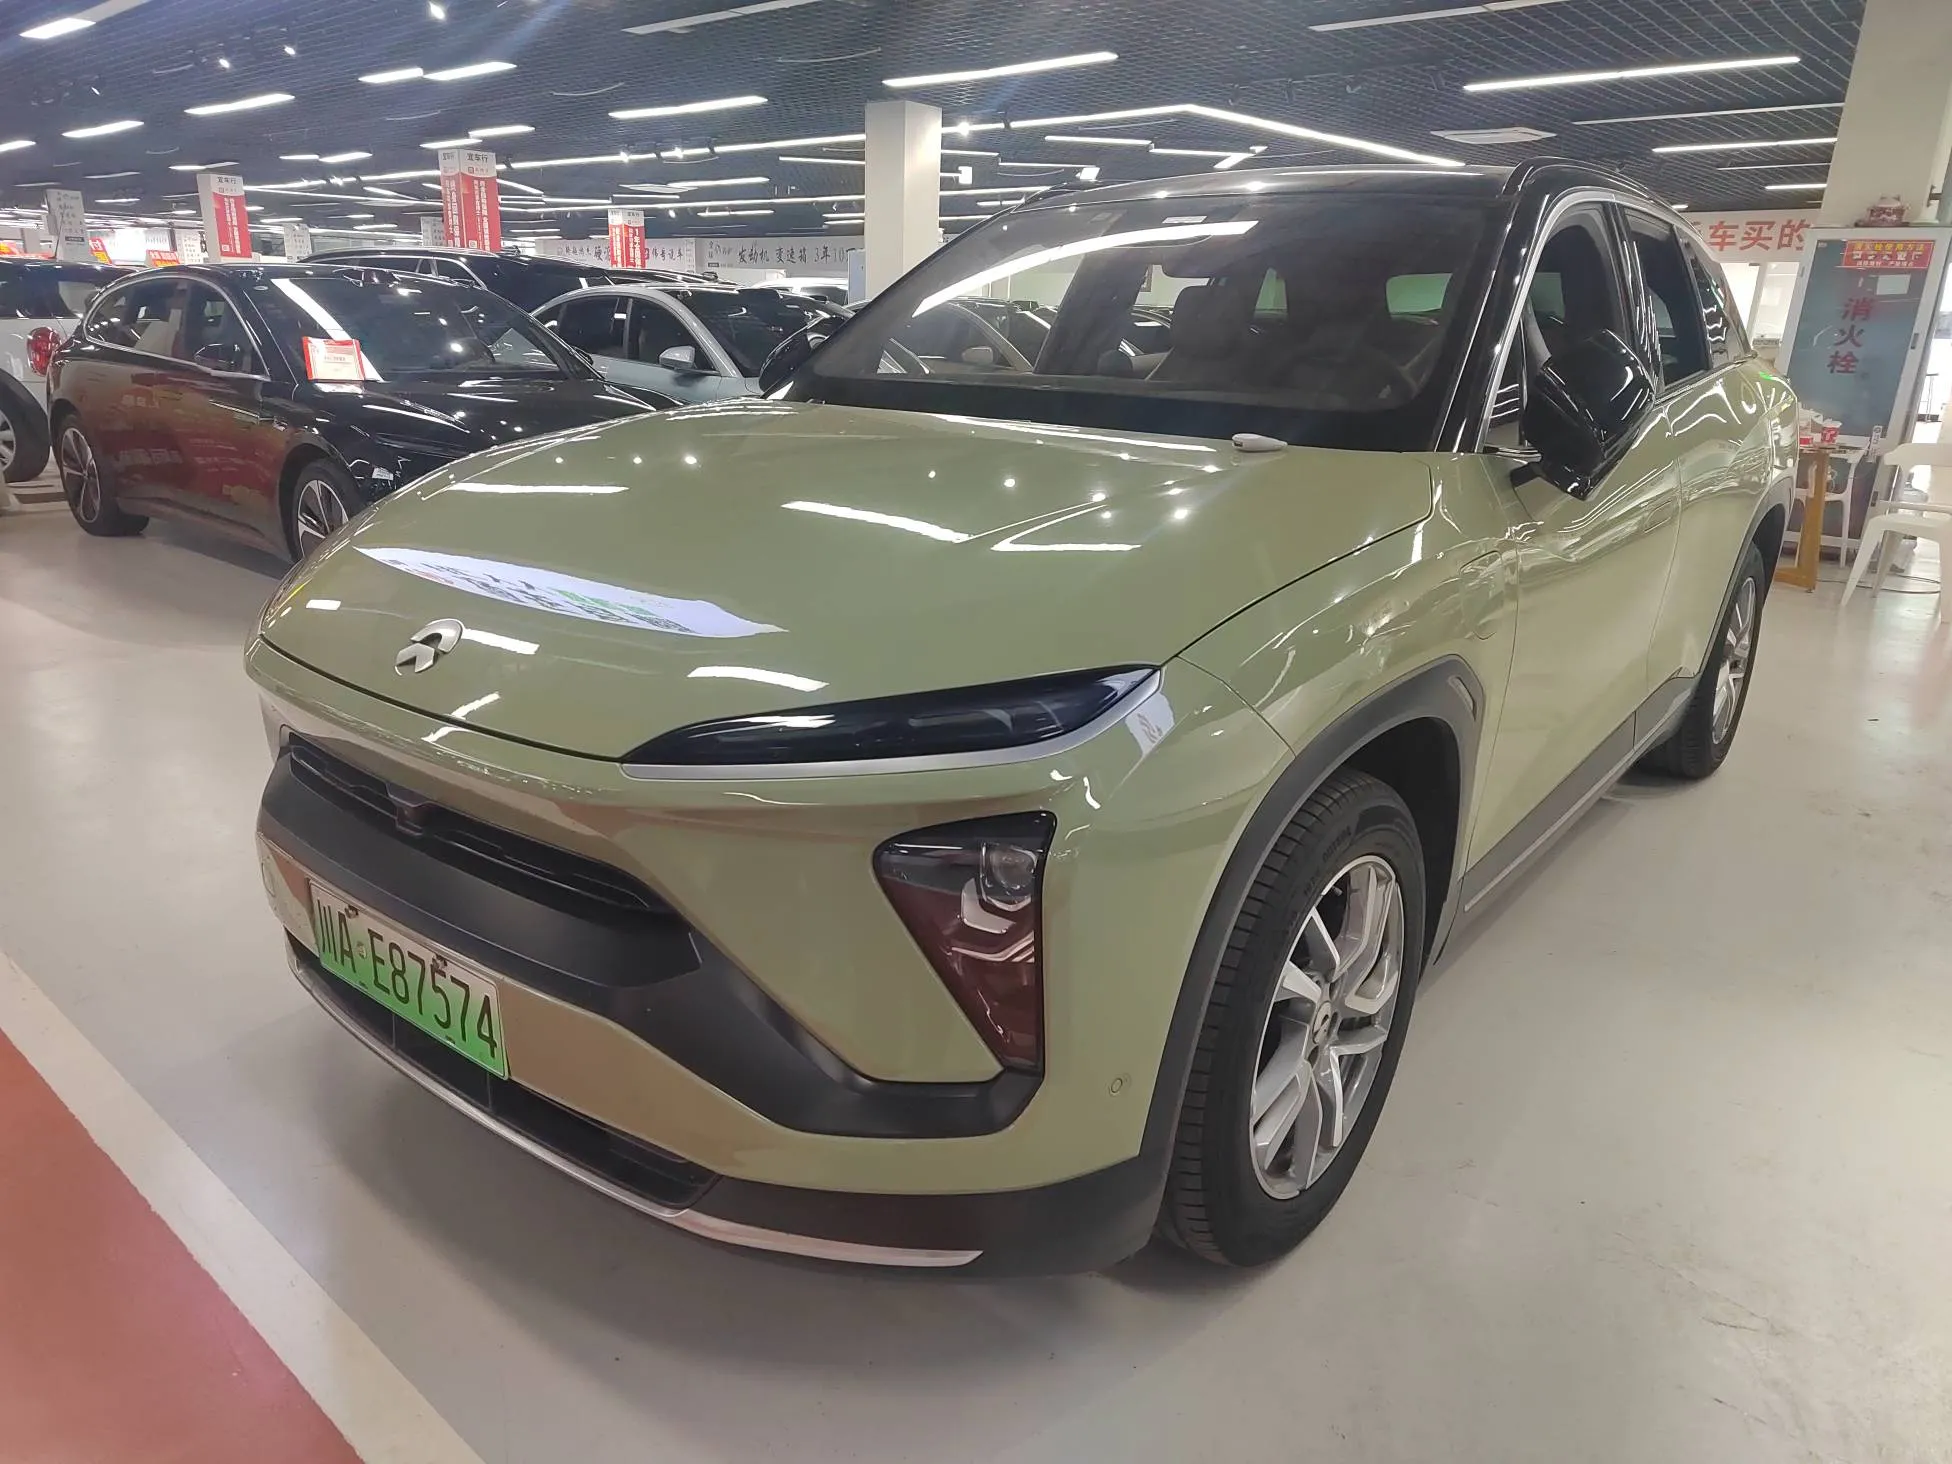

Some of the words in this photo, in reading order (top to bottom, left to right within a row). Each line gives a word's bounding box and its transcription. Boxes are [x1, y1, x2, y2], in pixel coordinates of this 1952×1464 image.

[1693, 219, 1811, 251] 车买的
[1826, 297, 1874, 374] 消火栓
